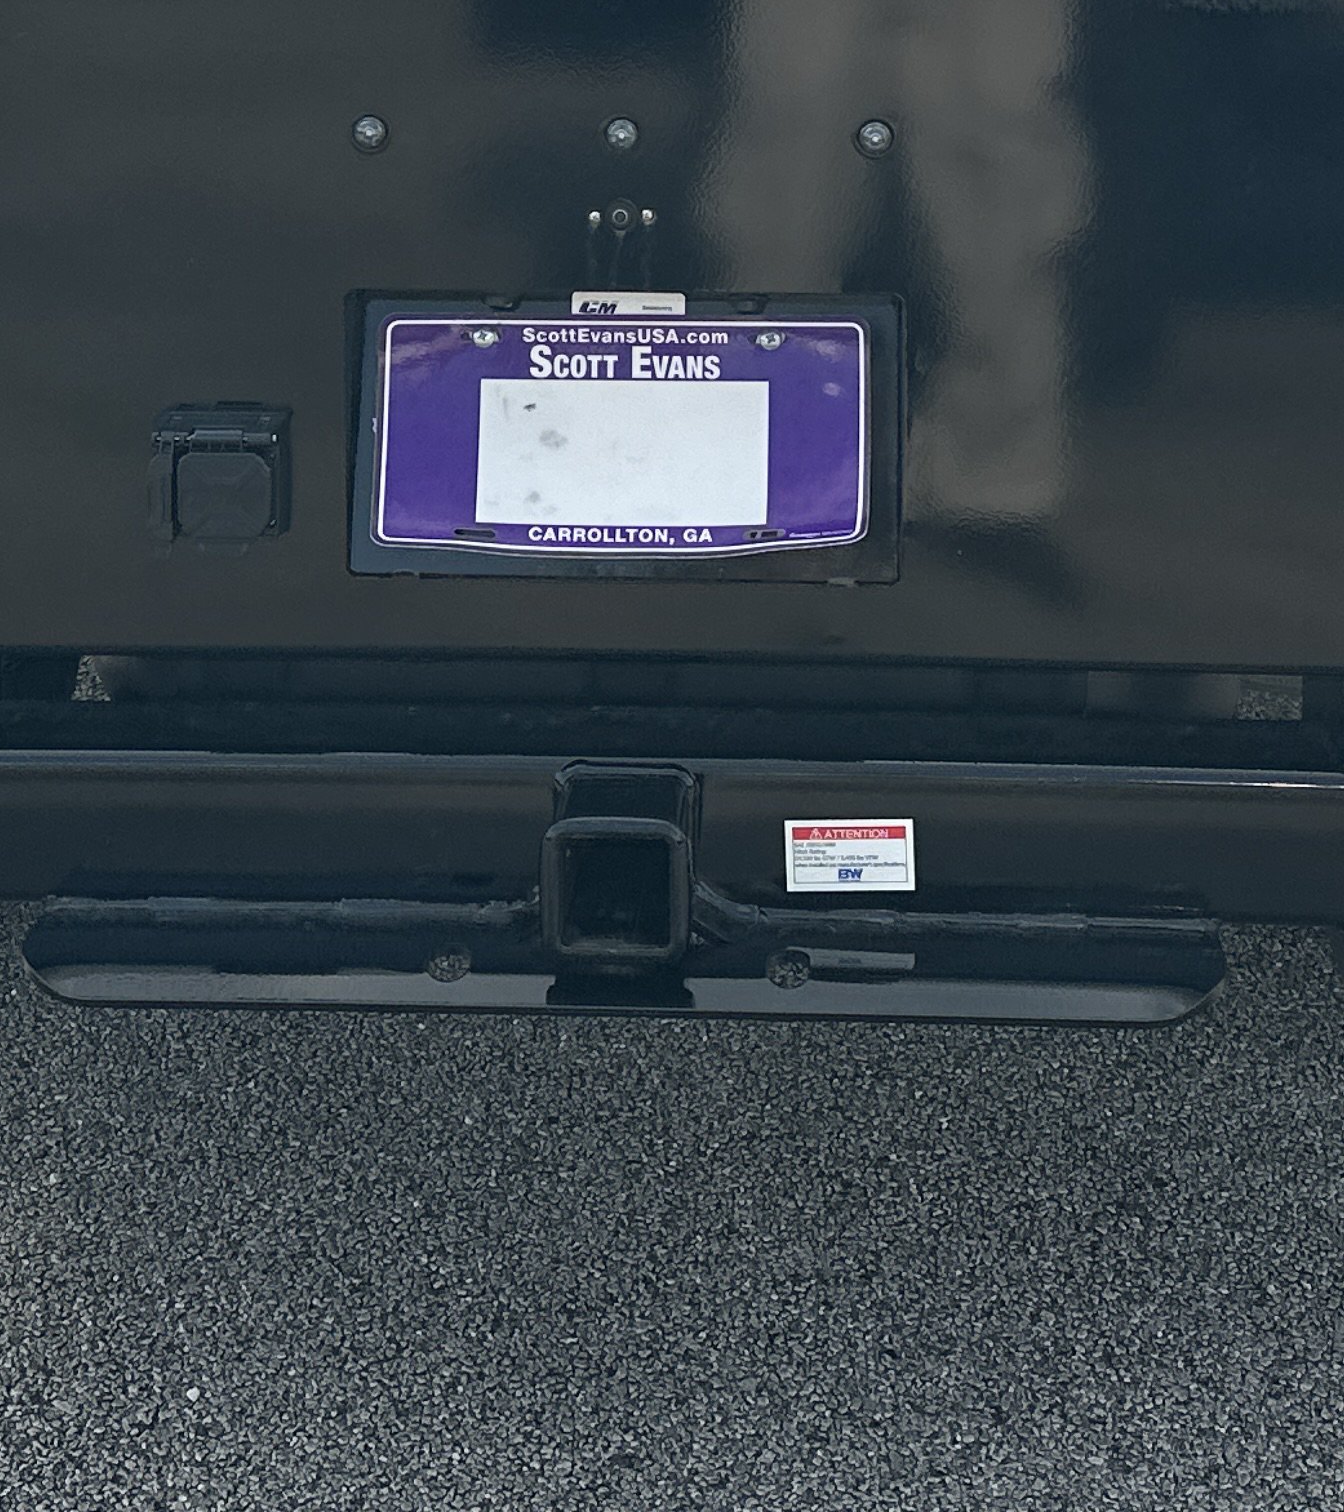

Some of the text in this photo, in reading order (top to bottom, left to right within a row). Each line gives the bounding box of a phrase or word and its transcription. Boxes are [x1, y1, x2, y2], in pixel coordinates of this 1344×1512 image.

[522, 327, 729, 344] ScottEvansUSA.com
[529, 344, 721, 380] SCOTT EVANS
[528, 527, 713, 546] CARROLLTON, GA
[824, 829, 889, 839] ATTENTION
